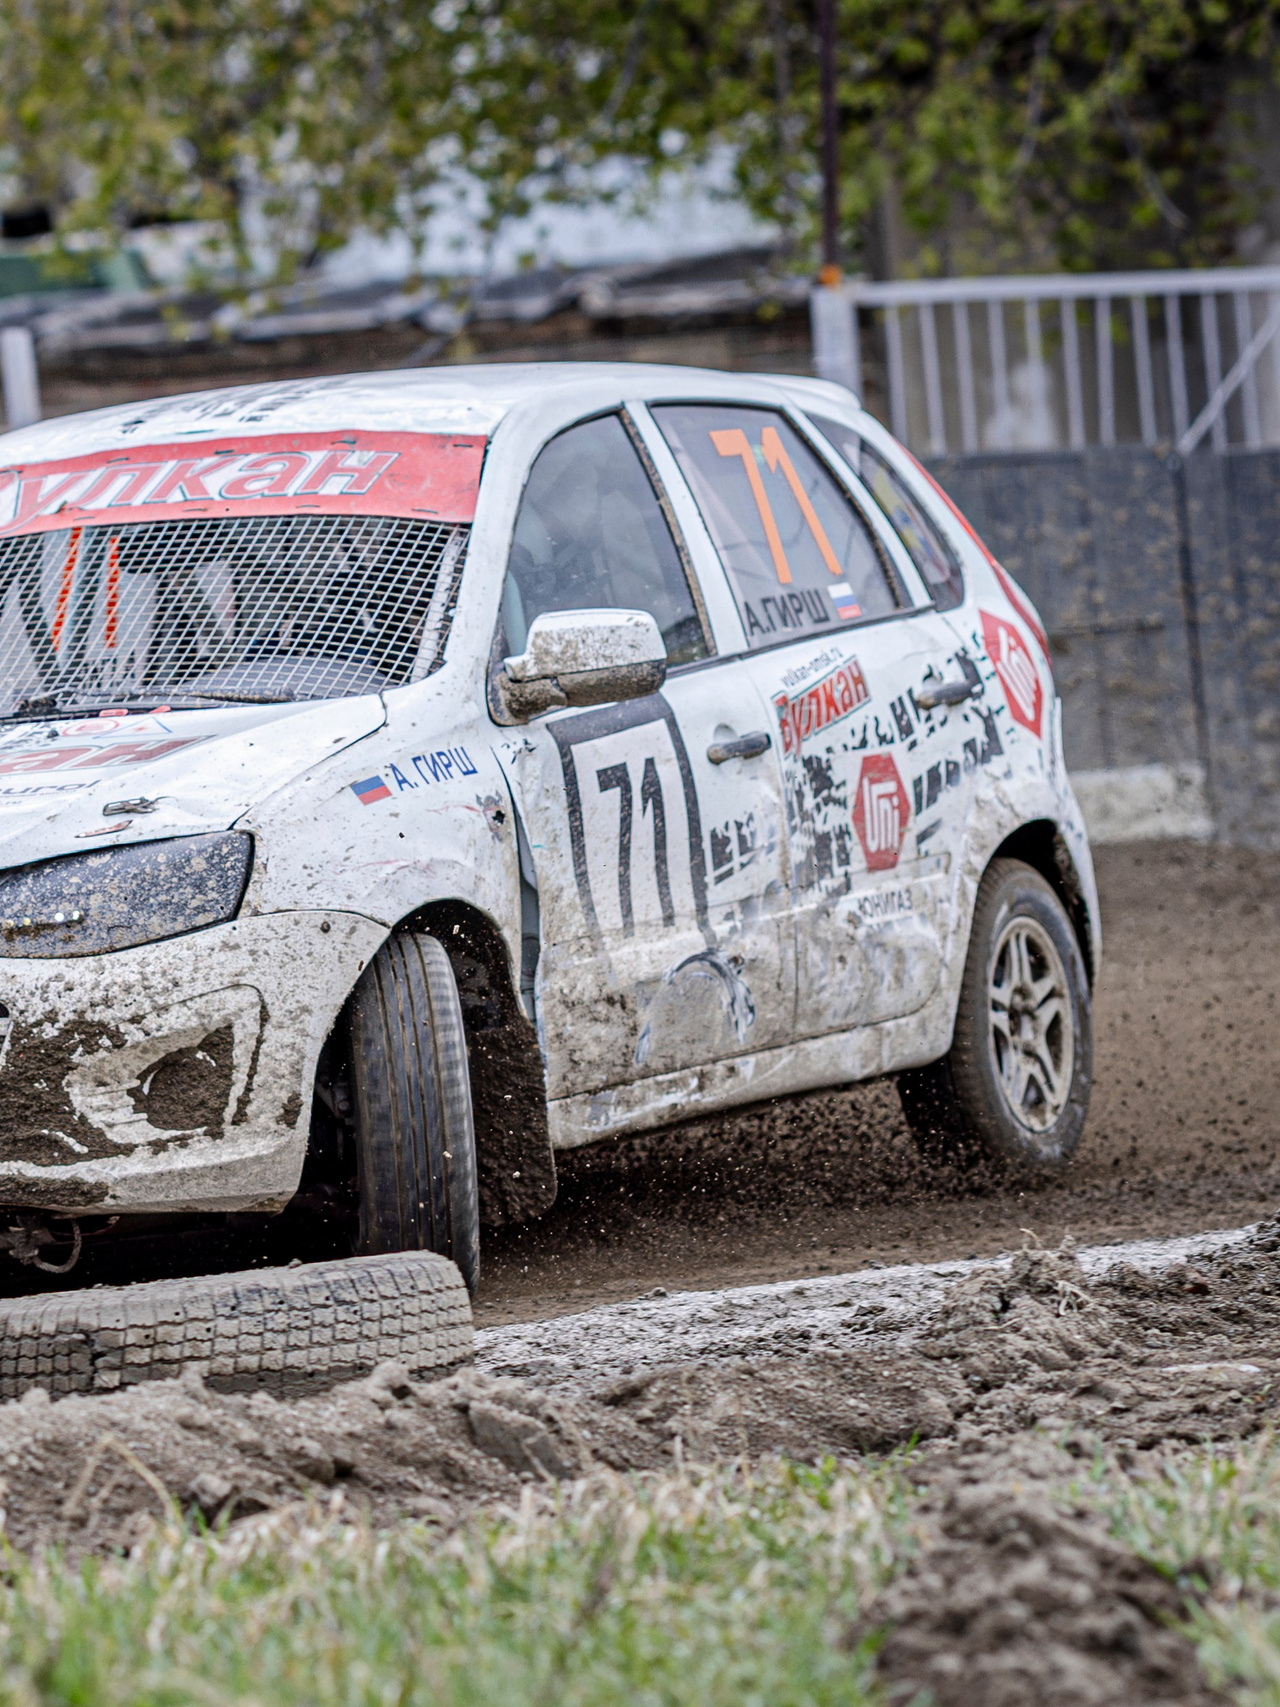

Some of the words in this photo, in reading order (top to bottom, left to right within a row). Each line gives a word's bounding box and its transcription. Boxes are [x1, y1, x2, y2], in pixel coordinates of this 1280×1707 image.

[709, 426, 843, 584] 71
[773, 657, 869, 759] Вулкан
[596, 757, 675, 938] 71
